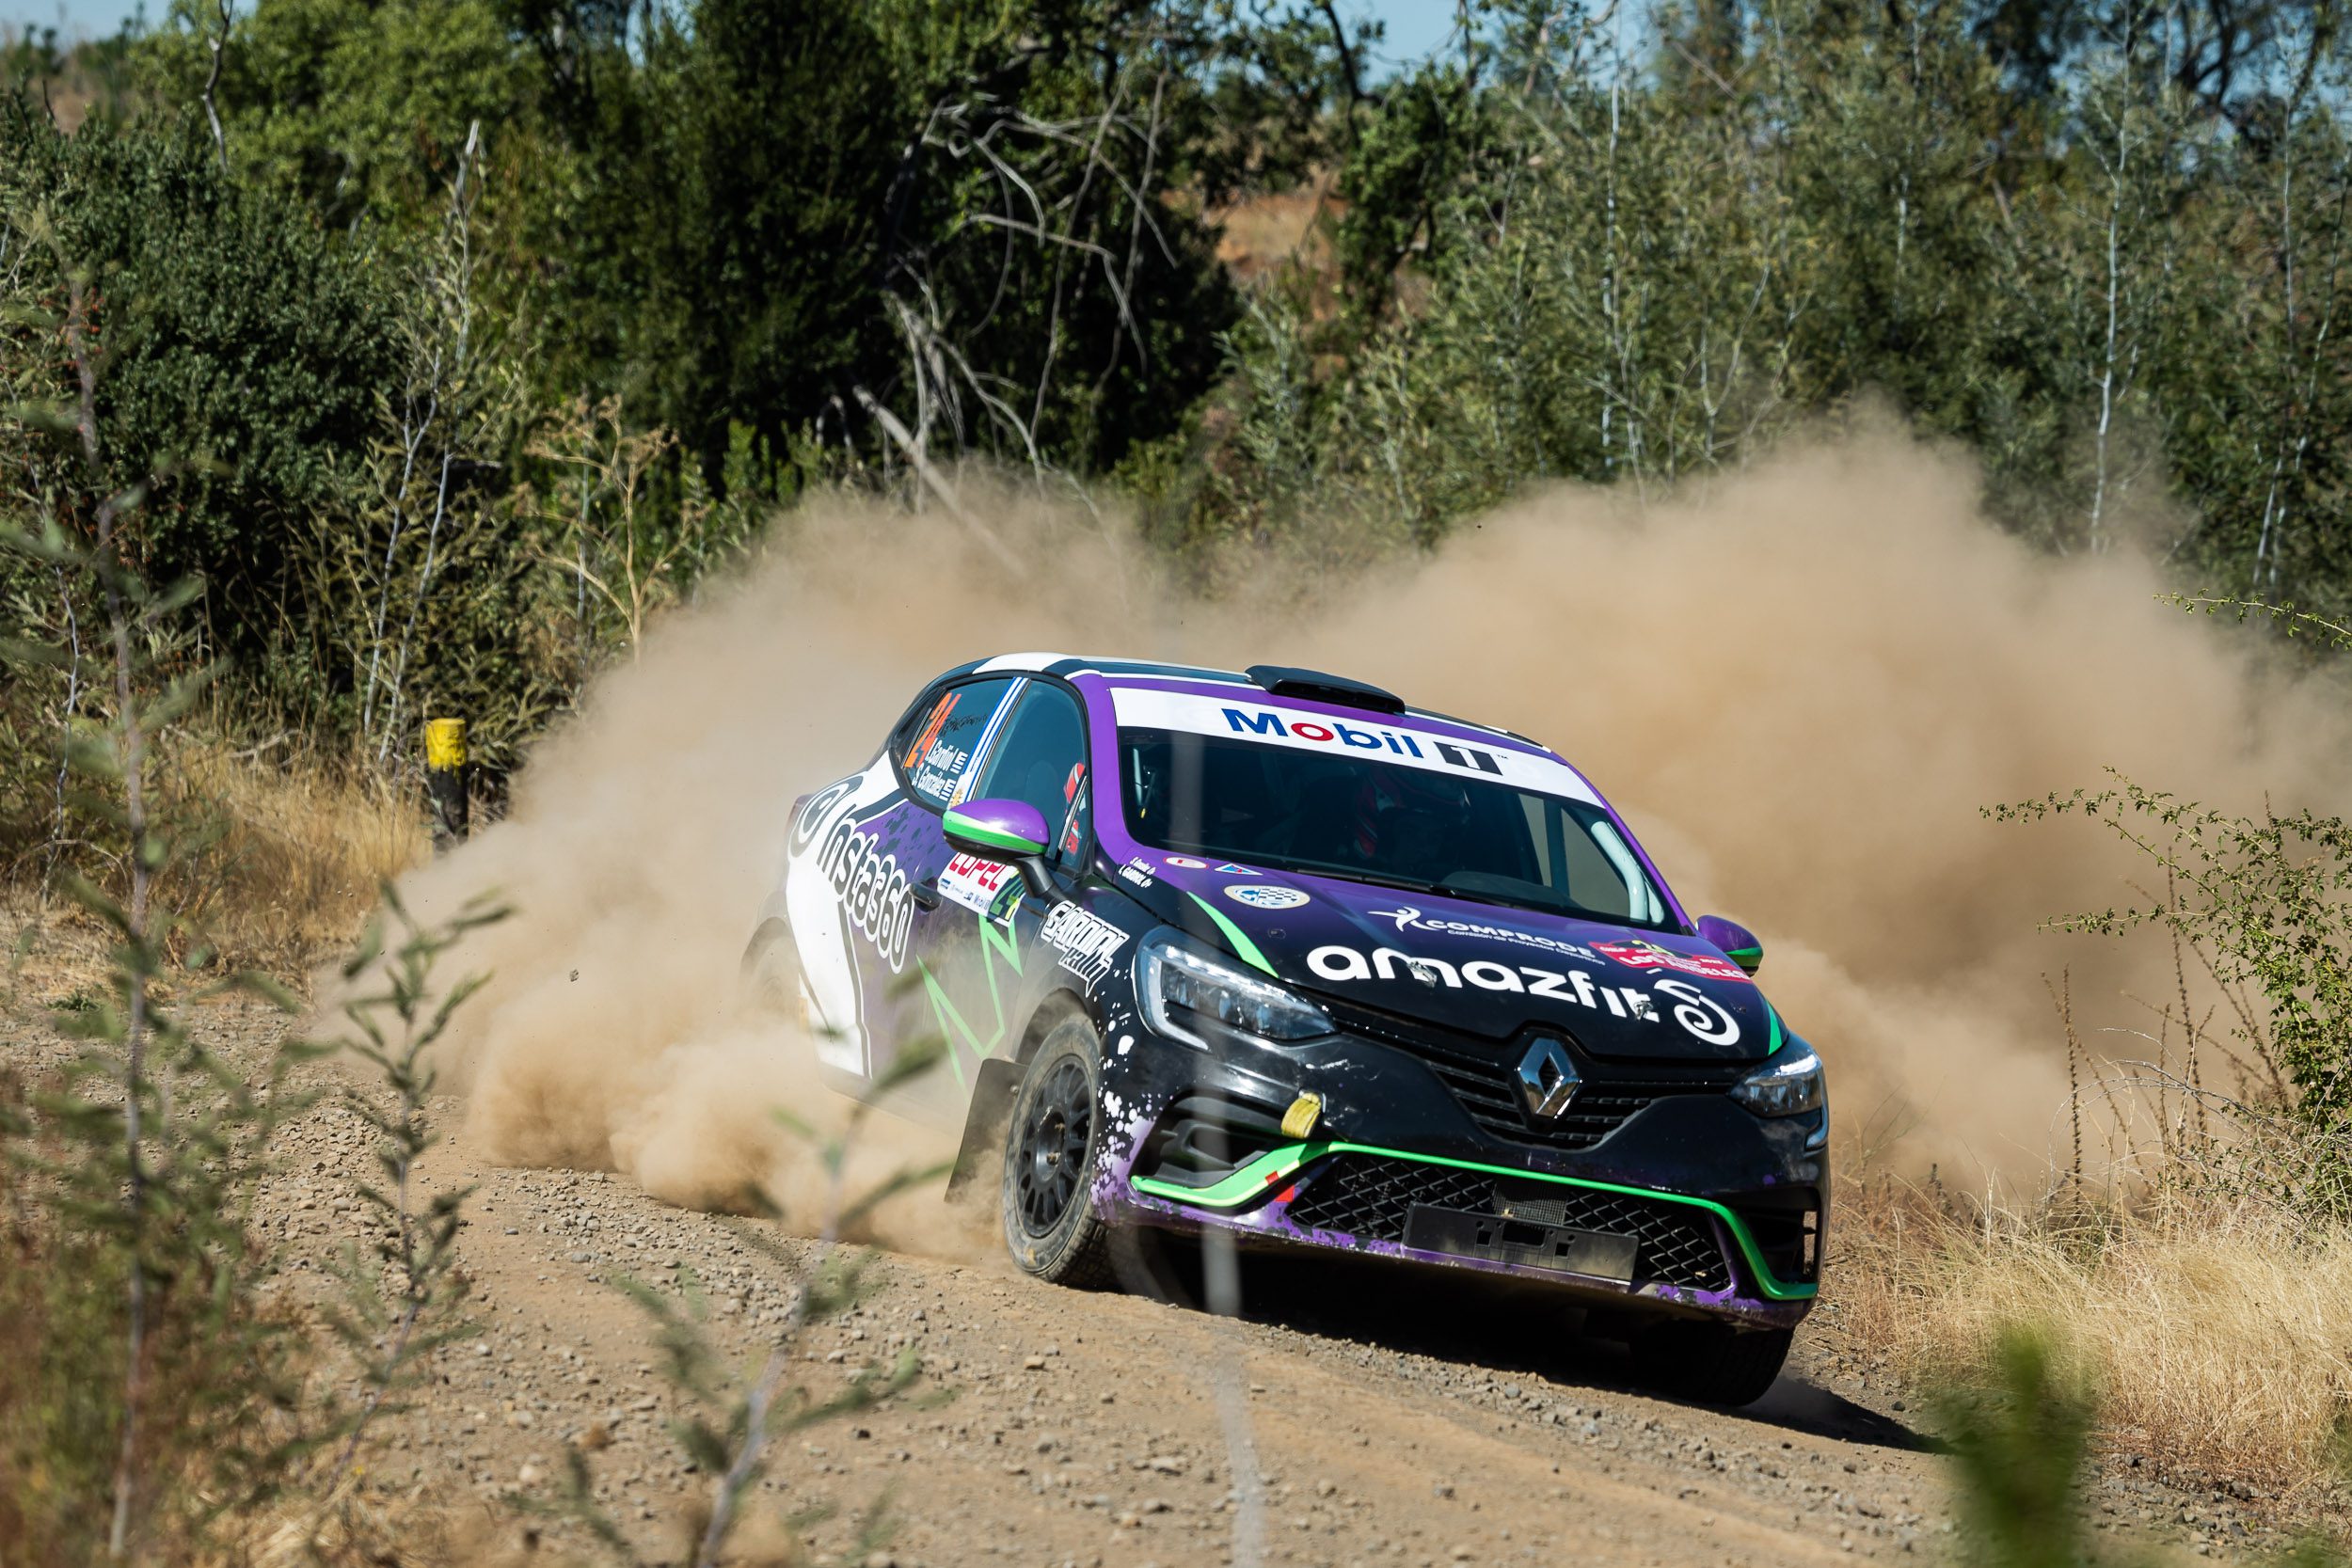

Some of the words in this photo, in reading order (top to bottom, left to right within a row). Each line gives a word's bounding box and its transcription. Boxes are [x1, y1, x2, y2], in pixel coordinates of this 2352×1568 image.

[1221, 708, 1423, 758] Mobil
[817, 803, 914, 971] Insta360
[1425, 919, 1596, 958] COMPRODE
[1306, 945, 1661, 1023] amazfit
